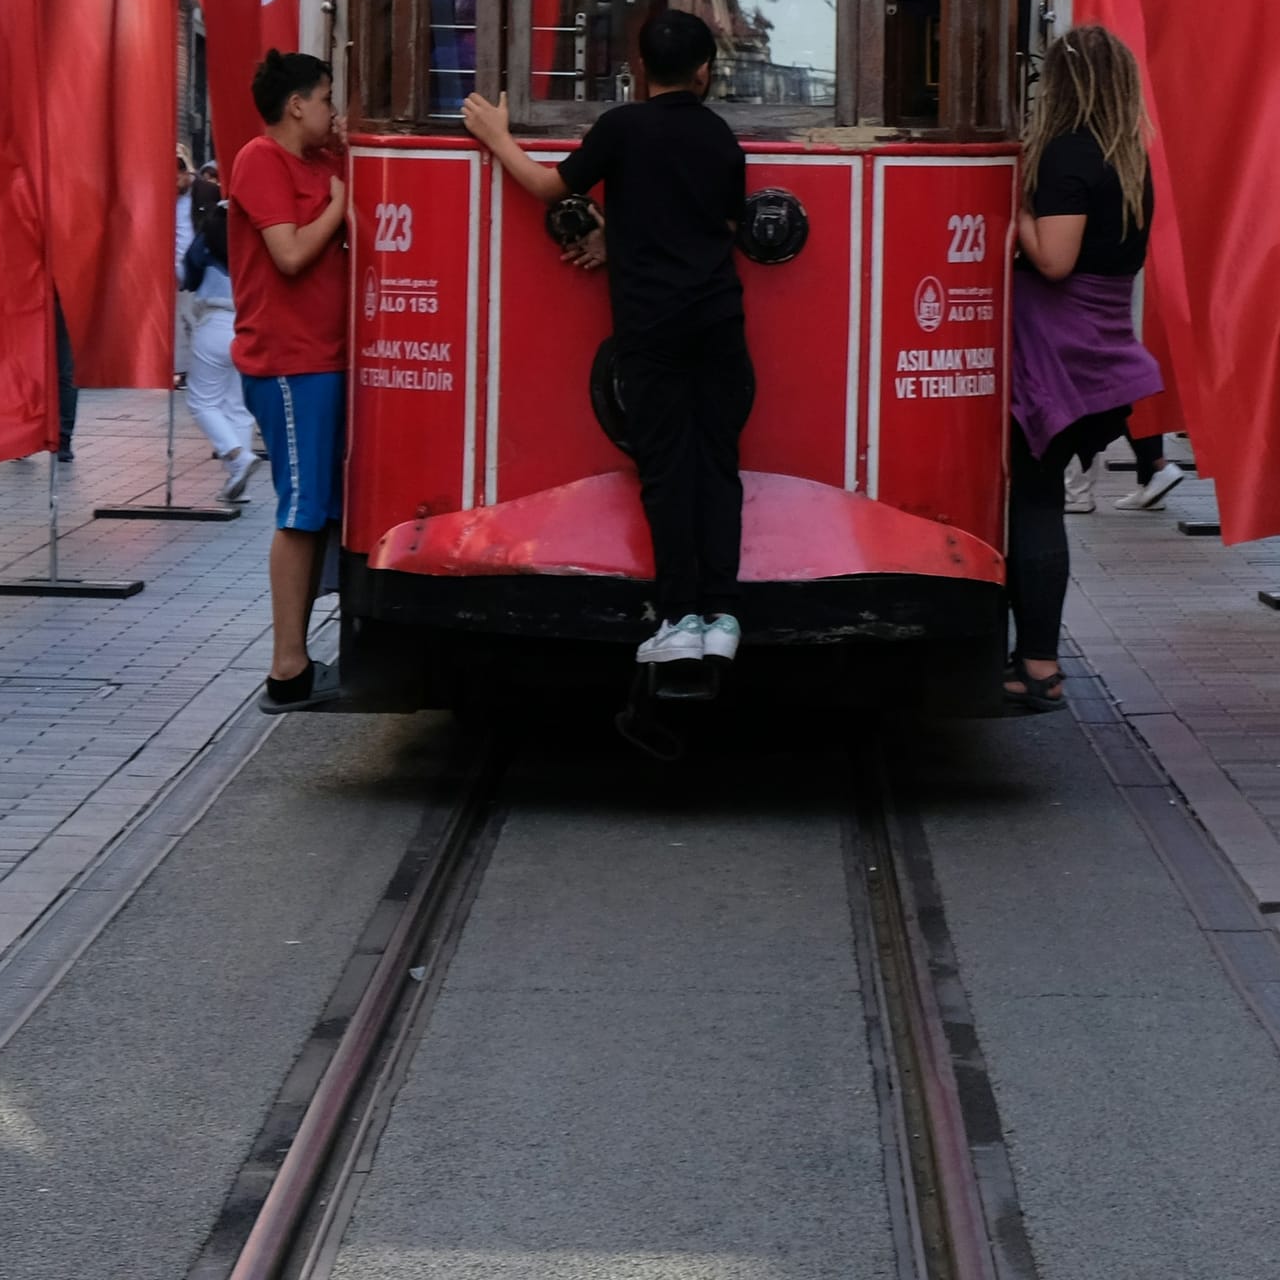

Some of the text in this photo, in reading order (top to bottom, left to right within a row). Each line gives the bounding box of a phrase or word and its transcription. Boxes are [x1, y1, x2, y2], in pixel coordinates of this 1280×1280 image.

[374, 202, 413, 253] 223
[947, 214, 986, 263] 223
[379, 296, 406, 313] ALO
[409, 297, 438, 314] 153
[948, 305, 975, 322] ALO
[403, 341, 452, 362] YASAK
[896, 348, 963, 372] ASILMAK
[369, 365, 453, 392] TEHLİKELİDİR
[895, 377, 917, 399] VE
